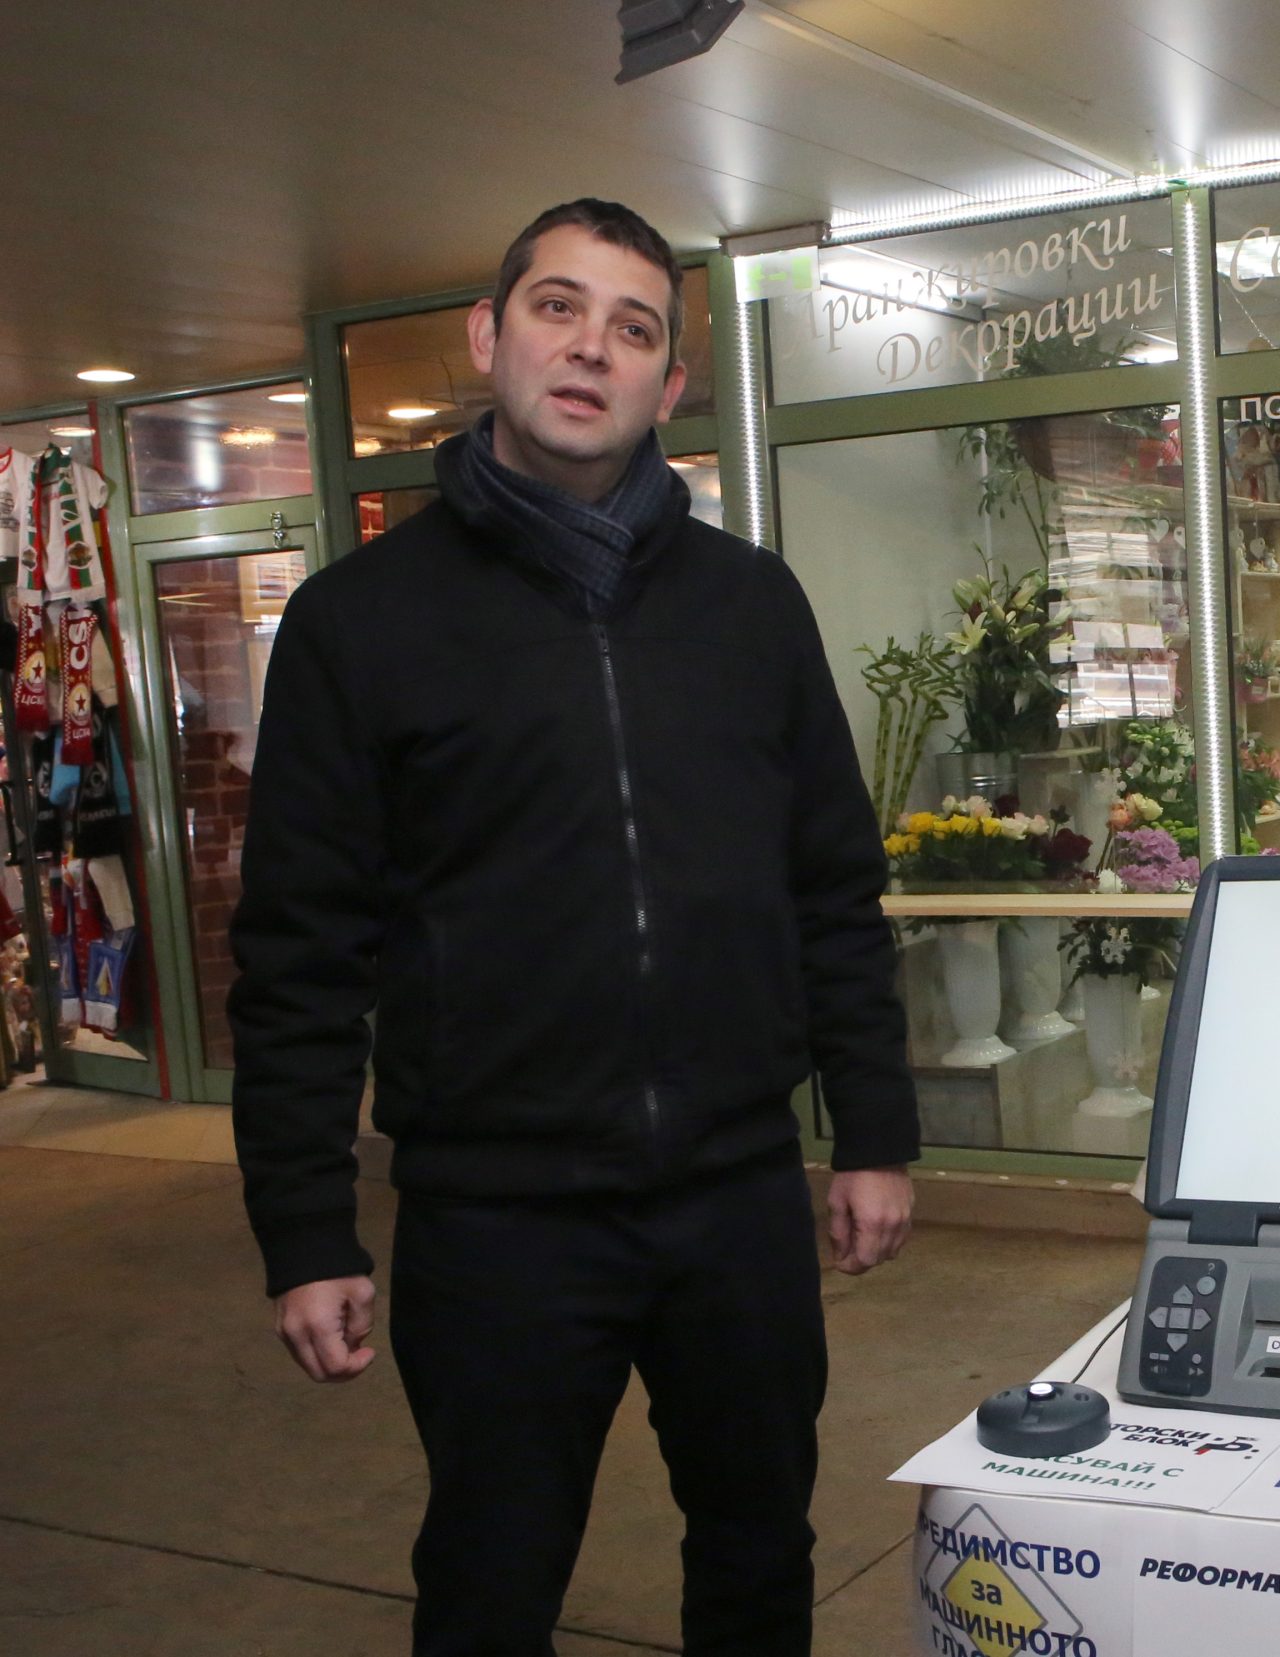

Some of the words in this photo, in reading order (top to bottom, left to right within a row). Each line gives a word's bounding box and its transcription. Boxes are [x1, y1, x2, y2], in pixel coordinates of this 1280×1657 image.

[877, 273, 1161, 384] Декорации
[1110, 1423, 1211, 1440] ТОРСКИ
[1122, 1434, 1197, 1448] БЛОК
[982, 1461, 1155, 1491] МАШИНА!!!
[1032, 1453, 1155, 1477] СУВАЙ
[1162, 1467, 1185, 1478] С
[971, 1580, 1003, 1606] за
[920, 1576, 1097, 1657] МАШИННОТО
